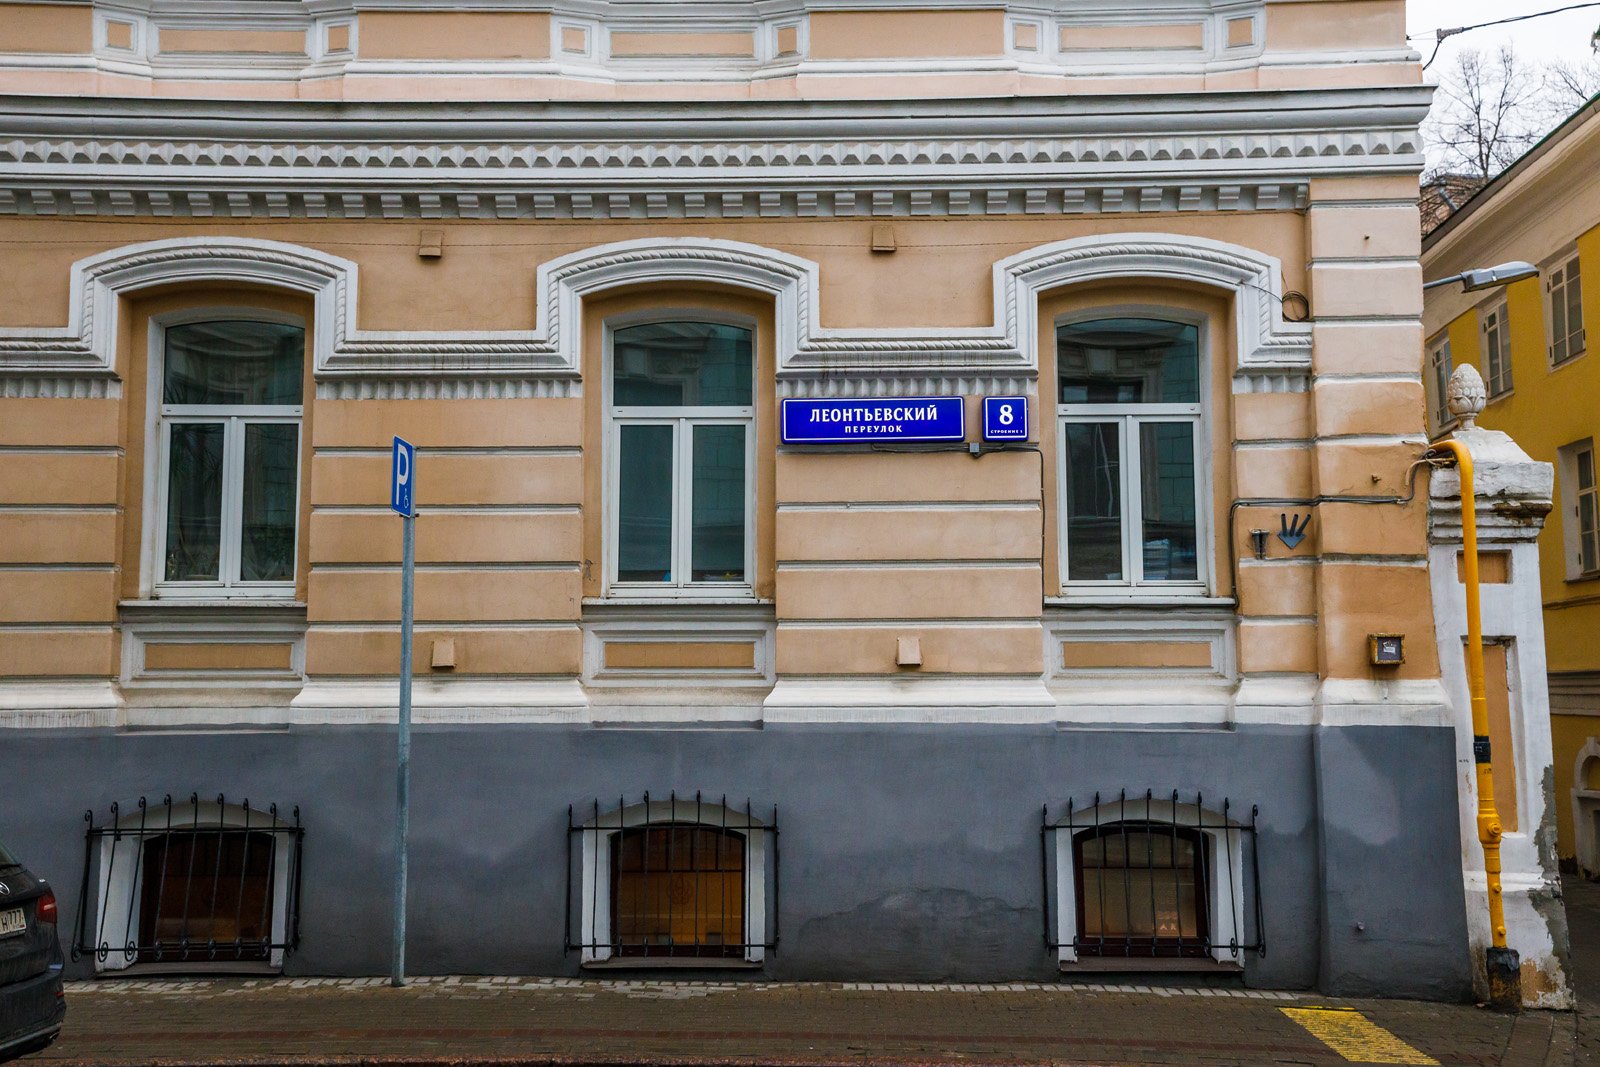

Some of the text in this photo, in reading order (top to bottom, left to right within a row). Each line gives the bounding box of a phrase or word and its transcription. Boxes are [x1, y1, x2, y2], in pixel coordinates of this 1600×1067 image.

[809, 404, 938, 422] ЛЕОНТЬЕВСКИЙ
[999, 404, 1014, 425] 8
[844, 425, 903, 433] ПЕРЕУЛОК
